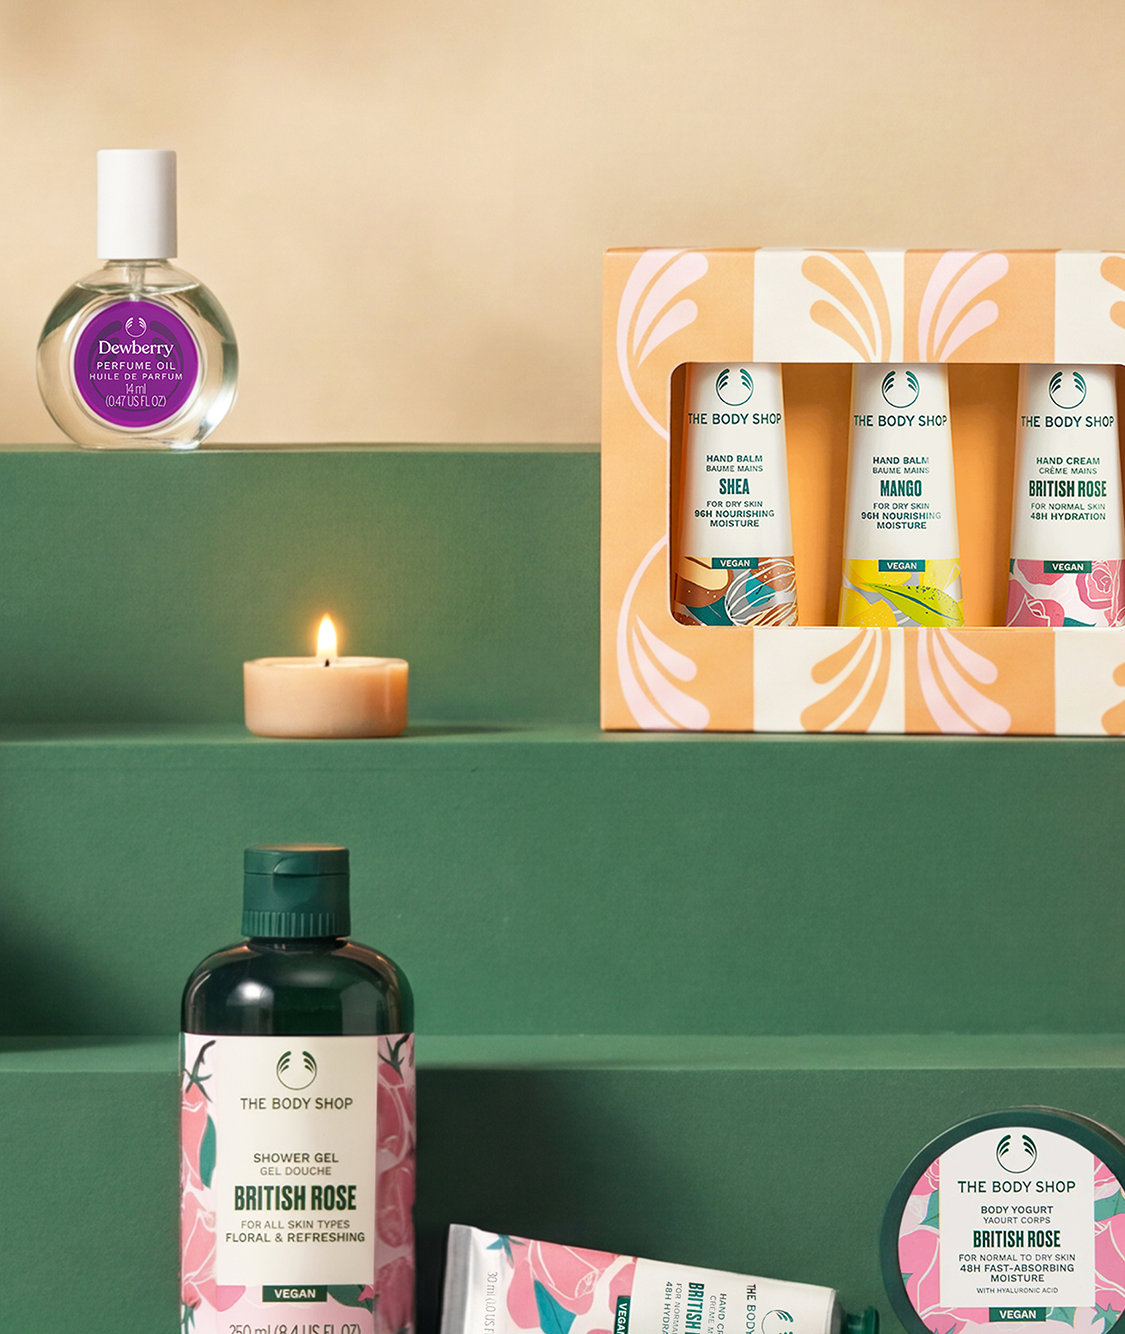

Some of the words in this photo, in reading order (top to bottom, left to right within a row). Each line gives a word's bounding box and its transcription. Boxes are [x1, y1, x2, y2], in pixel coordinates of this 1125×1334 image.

[98, 340, 174, 358] Dewberry
[97, 361, 151, 370] PERFUME
[156, 361, 176, 370] OIL
[125, 383, 134, 394] 14
[135, 383, 146, 394] ml
[127, 395, 139, 407] US
[688, 413, 708, 425] THE
[712, 413, 749, 425] BODY
[752, 413, 782, 425] SHOP
[854, 415, 873, 427] THE
[878, 415, 915, 427] BODY
[918, 415, 947, 427] SHOP
[1021, 416, 1041, 427] THE
[1045, 416, 1082, 427] BODY
[1085, 416, 1114, 427] SHOP
[1036, 457, 1063, 465] HAND
[1066, 457, 1100, 465] CREAM
[1039, 466, 1068, 474] CRÈME
[719, 478, 750, 495] SHEA
[880, 480, 922, 497] MANGO
[1029, 480, 1075, 497] BRITISH
[1078, 480, 1107, 497] ROSE
[694, 510, 713, 518] 96H
[715, 510, 775, 518] NOURISHING
[240, 1098, 267, 1110] THE
[272, 1098, 311, 1110] BODY
[315, 1097, 353, 1110] SHOP
[253, 1153, 310, 1163] SHOWER
[314, 1153, 339, 1163] GEL
[260, 1166, 281, 1176] GEL
[285, 1166, 332, 1176] DOUCHE
[957, 1181, 987, 1193] THE
[991, 1181, 1032, 1193] BODY
[1035, 1181, 1076, 1193] SHOP
[234, 1185, 306, 1211] BRITISH
[311, 1184, 357, 1211] ROSE
[981, 1205, 1010, 1214] BODY
[1012, 1205, 1054, 1214] YOGURT
[225, 1232, 271, 1243] FLORAL
[274, 1232, 283, 1243] &
[287, 1232, 365, 1243] REFRESHING
[973, 1230, 1024, 1248] BRITISH
[1027, 1230, 1061, 1248] ROSE
[990, 1274, 1045, 1283] MOISTURE
[274, 1289, 316, 1299] VEGAN
[664, 1281, 673, 1301] 48H
[684, 1282, 705, 1330] BRITISH
[999, 1310, 1036, 1319] VEGAN
